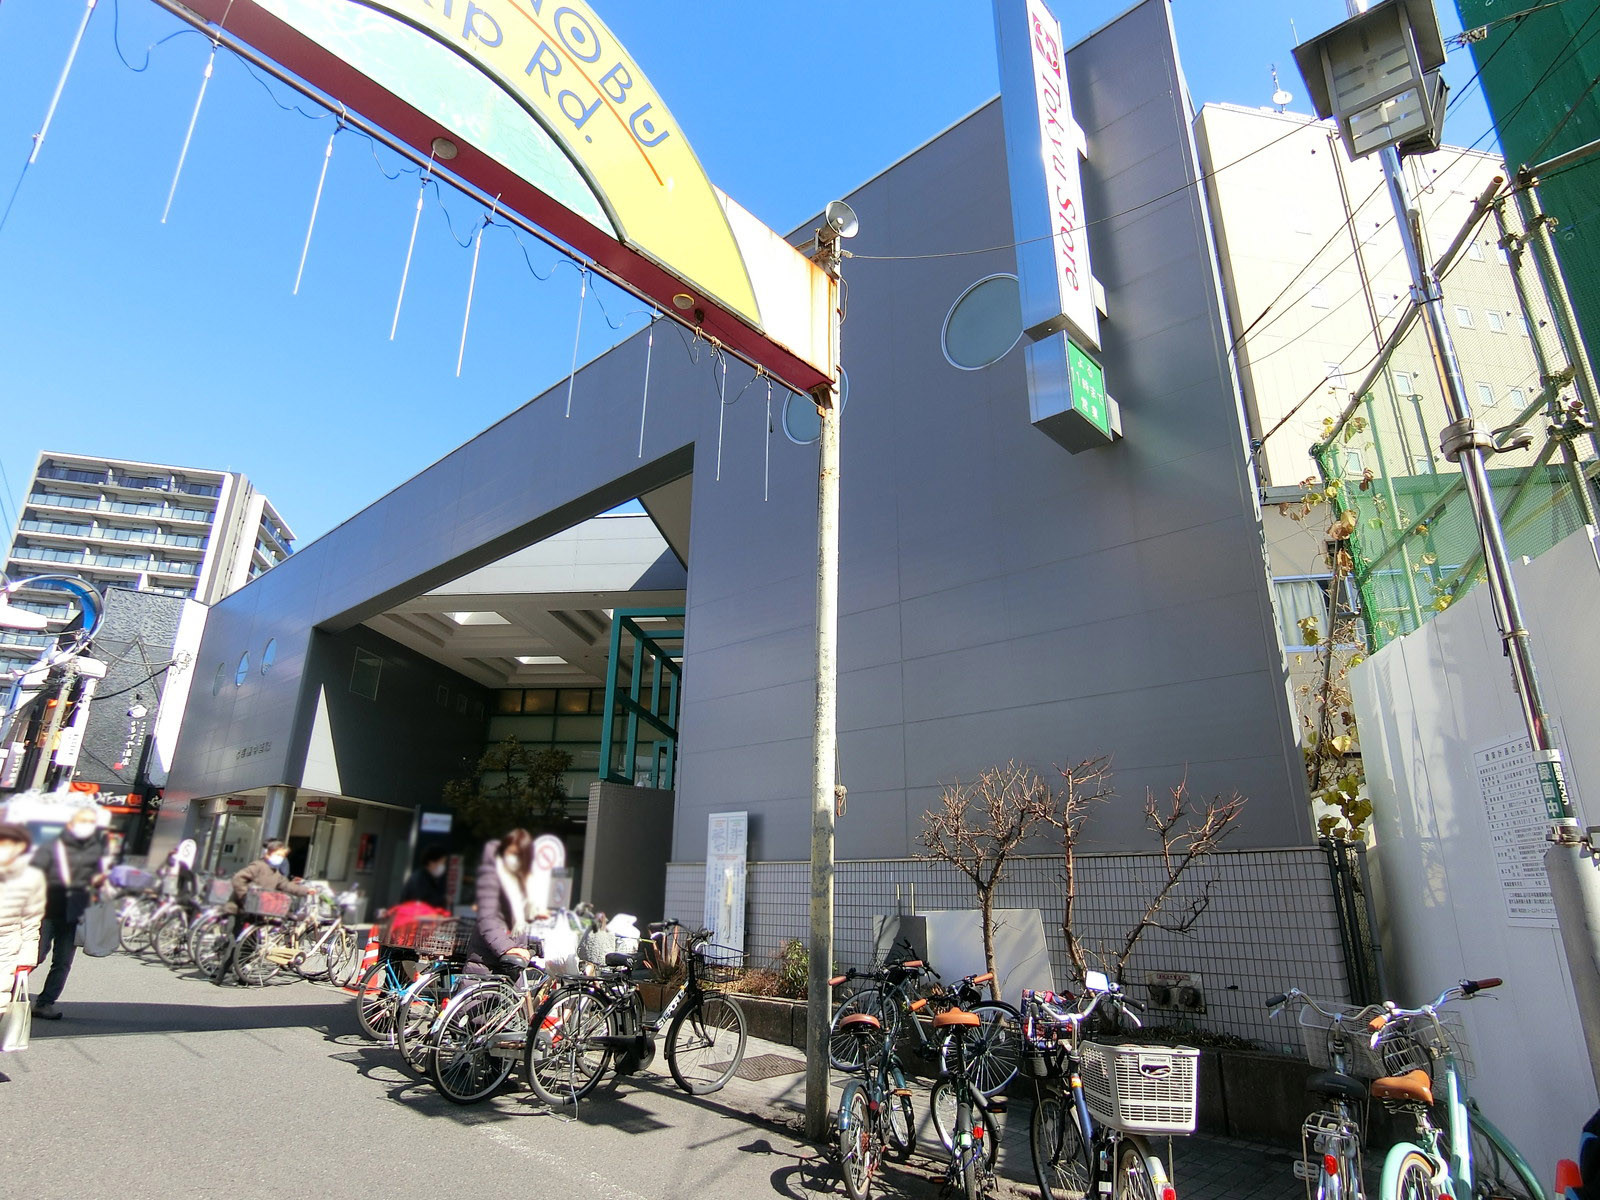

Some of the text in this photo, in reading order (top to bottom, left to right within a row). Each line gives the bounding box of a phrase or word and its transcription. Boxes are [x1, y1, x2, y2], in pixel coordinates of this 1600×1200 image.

[525, 40, 603, 143] Rd.
[530, 0, 670, 147] OBU
[1042, 71, 1079, 291] Tokyu Store
[1537, 763, 1560, 818] 録画中
